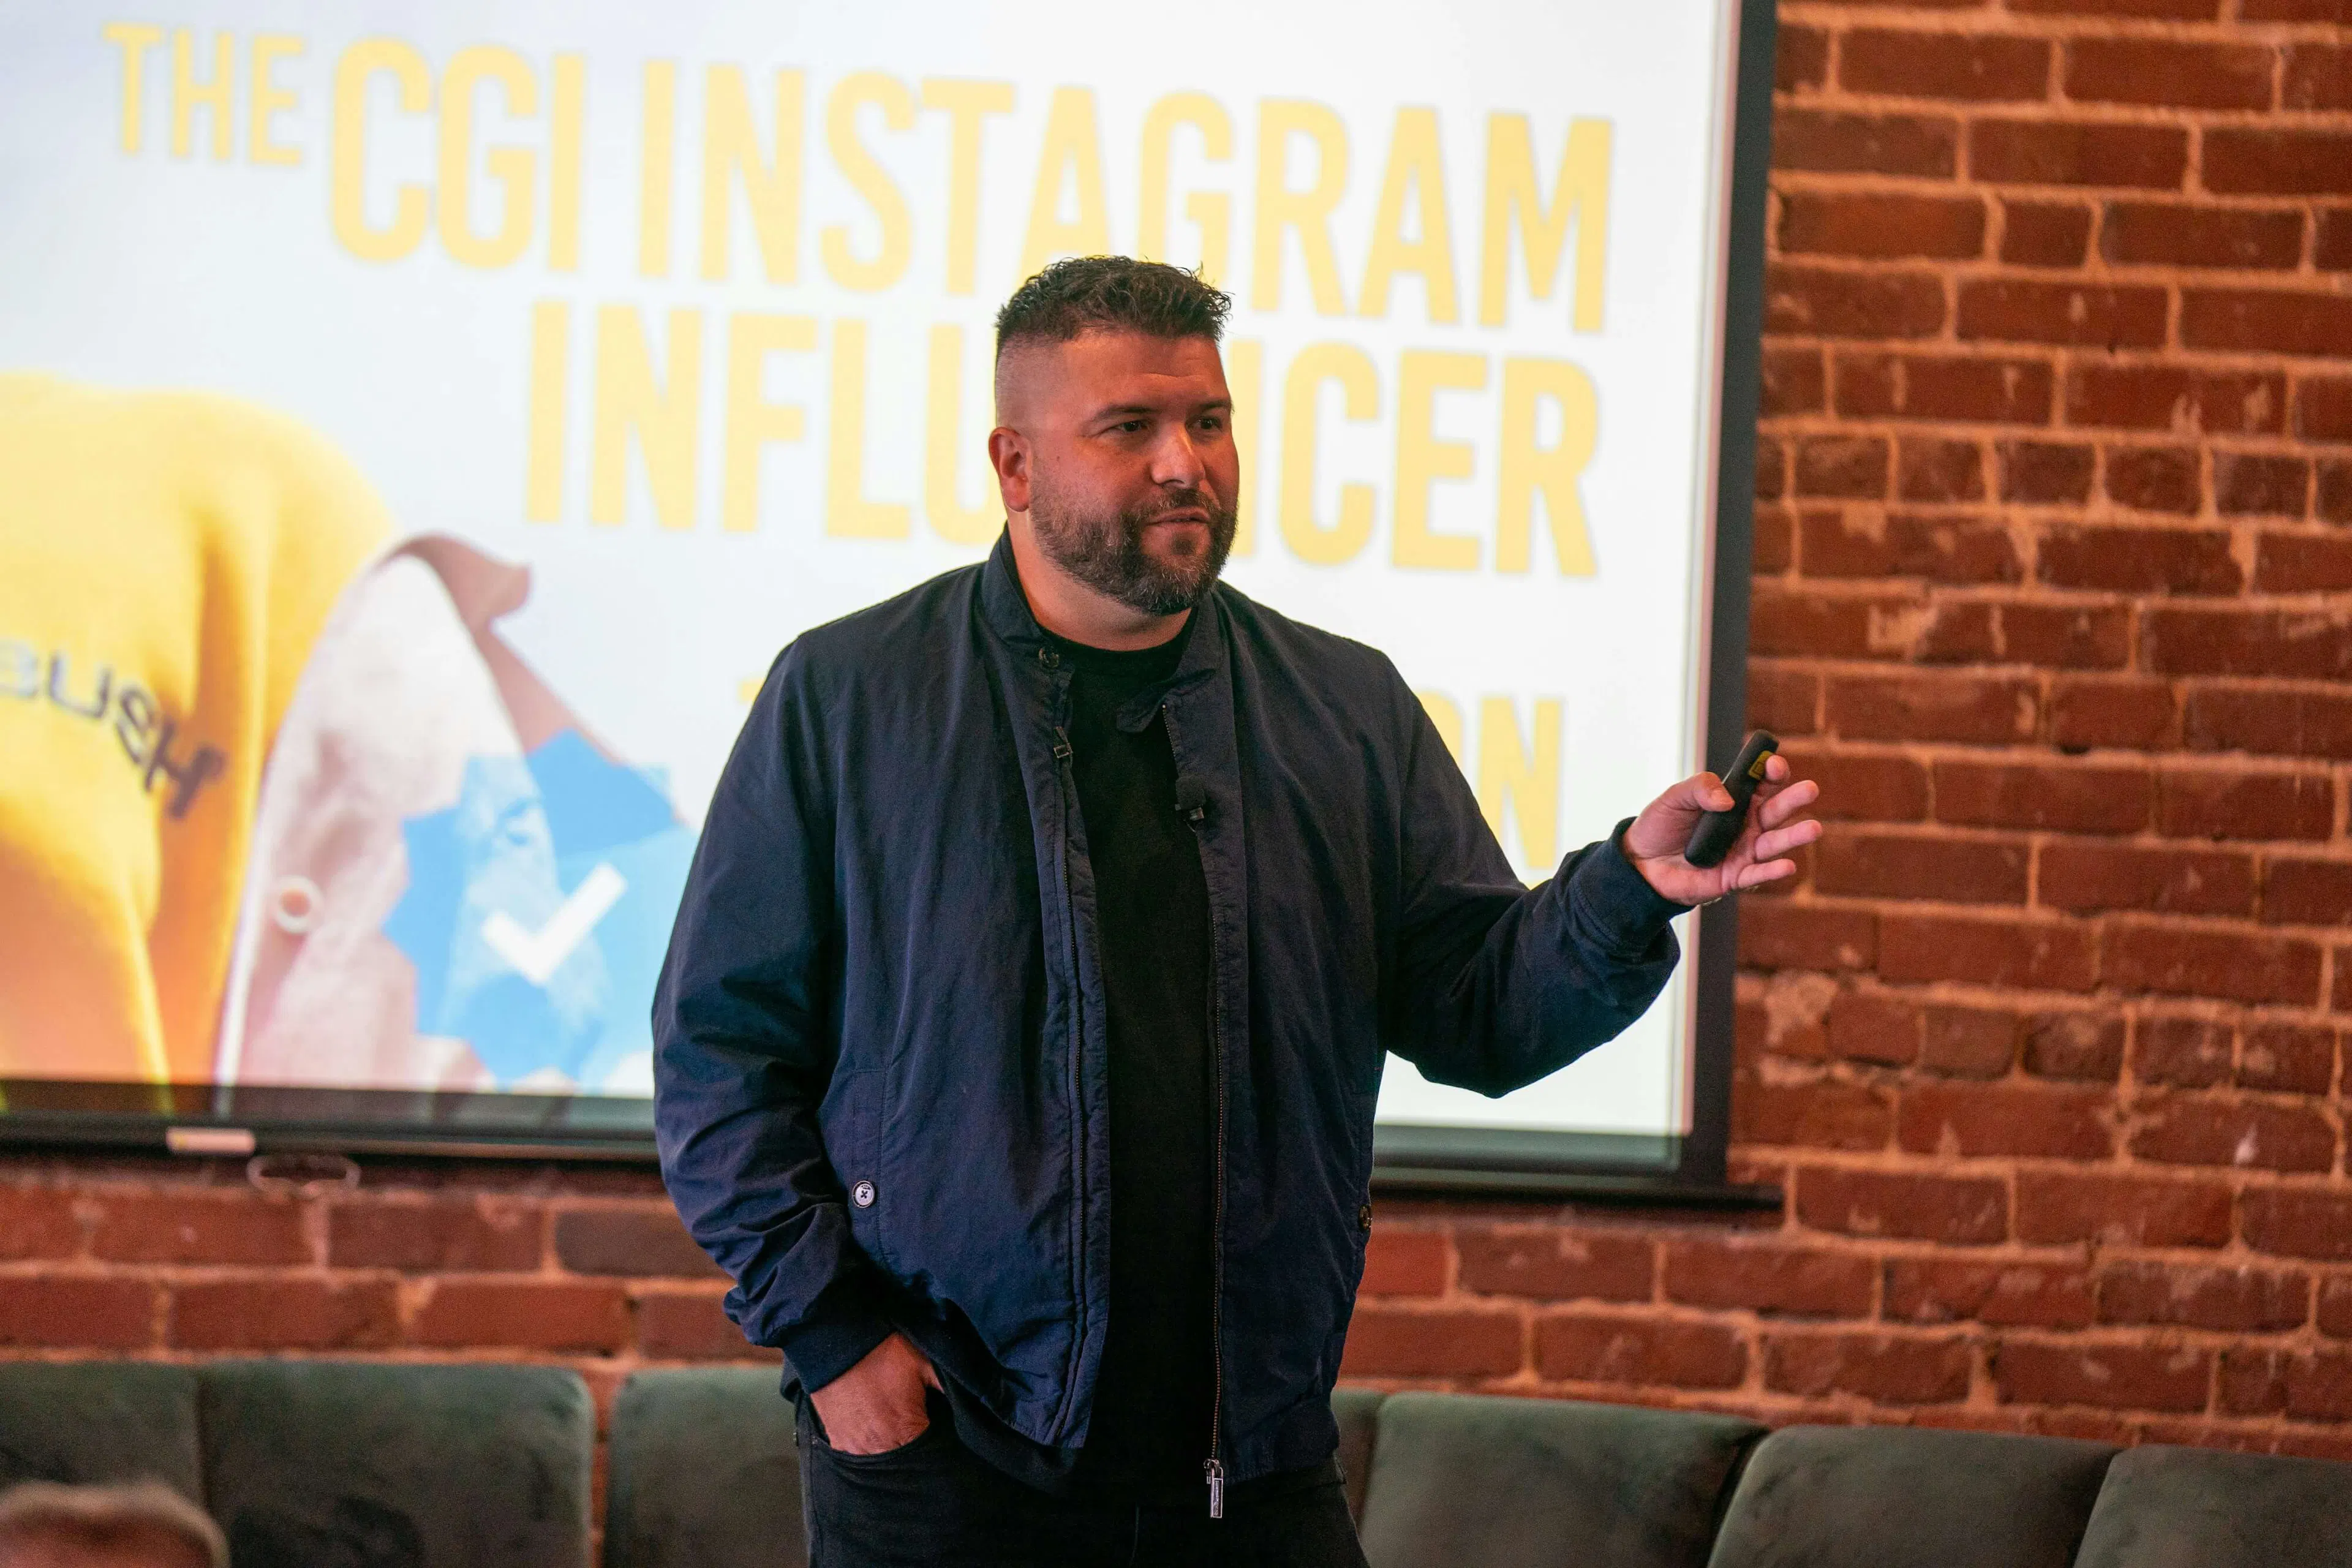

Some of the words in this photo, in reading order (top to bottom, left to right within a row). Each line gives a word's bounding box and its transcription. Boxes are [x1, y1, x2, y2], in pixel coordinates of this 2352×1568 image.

[103, 22, 305, 167] THE
[330, 37, 585, 272] CGI
[638, 58, 1613, 334] INSTAGRAM
[526, 300, 1600, 579] INFLUCER
